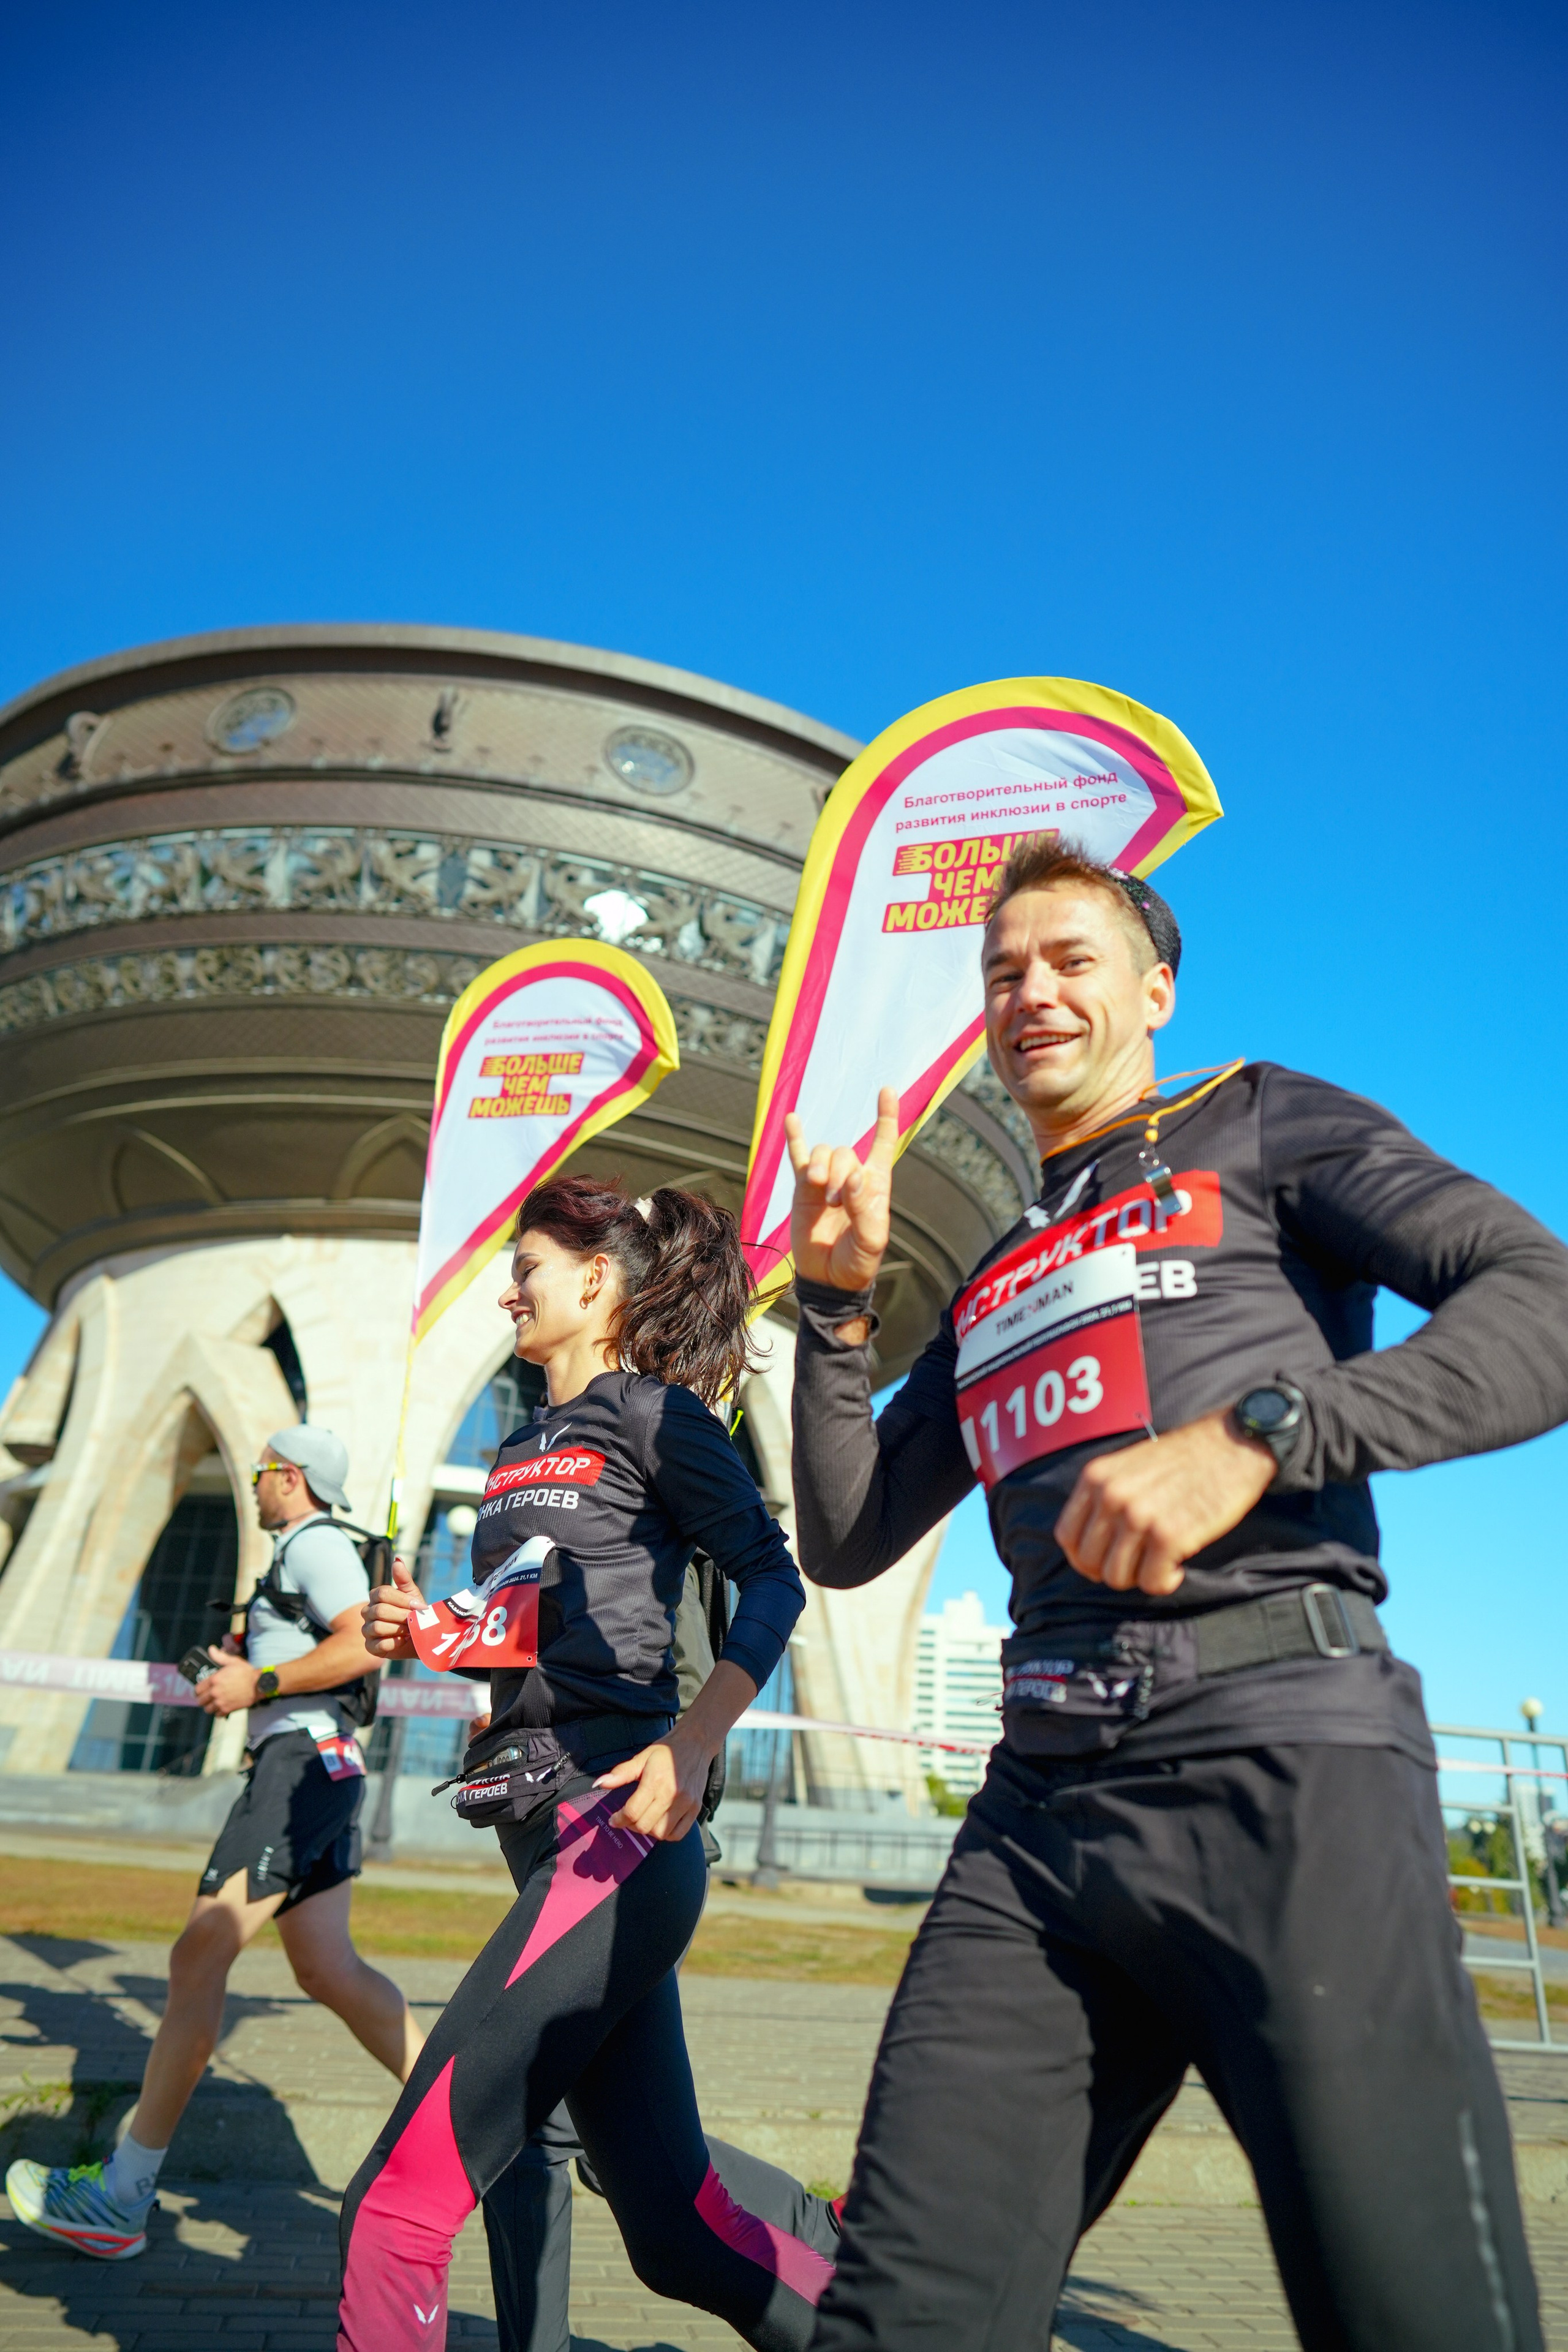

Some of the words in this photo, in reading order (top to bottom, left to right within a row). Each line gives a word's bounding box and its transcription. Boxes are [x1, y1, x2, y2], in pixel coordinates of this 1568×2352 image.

[904, 778, 1068, 808] Благотворительный
[1073, 772, 1118, 790] фонд
[895, 813, 965, 833] развития
[971, 804, 1050, 821] инклюзии
[1056, 801, 1066, 812] в
[1071, 793, 1127, 809] спорте
[933, 864, 1005, 898] ЧЕМ
[885, 895, 996, 932] МОЖЕ
[485, 1053, 583, 1076] БОЛЬШЕ
[503, 1074, 551, 1095] ЧЕМ
[469, 1094, 570, 1118] МОЖЕШЬ
[980, 1355, 1104, 1454] 1103
[504, 1488, 579, 1511] ГЕРОЕВ
[469, 1782, 508, 1800] ГЕРОЕВ
[595, 1815, 605, 1828] TIME
[603, 1825, 610, 1833] TO
[608, 1830, 615, 1839] BE
[612, 1836, 624, 1849] HERO
